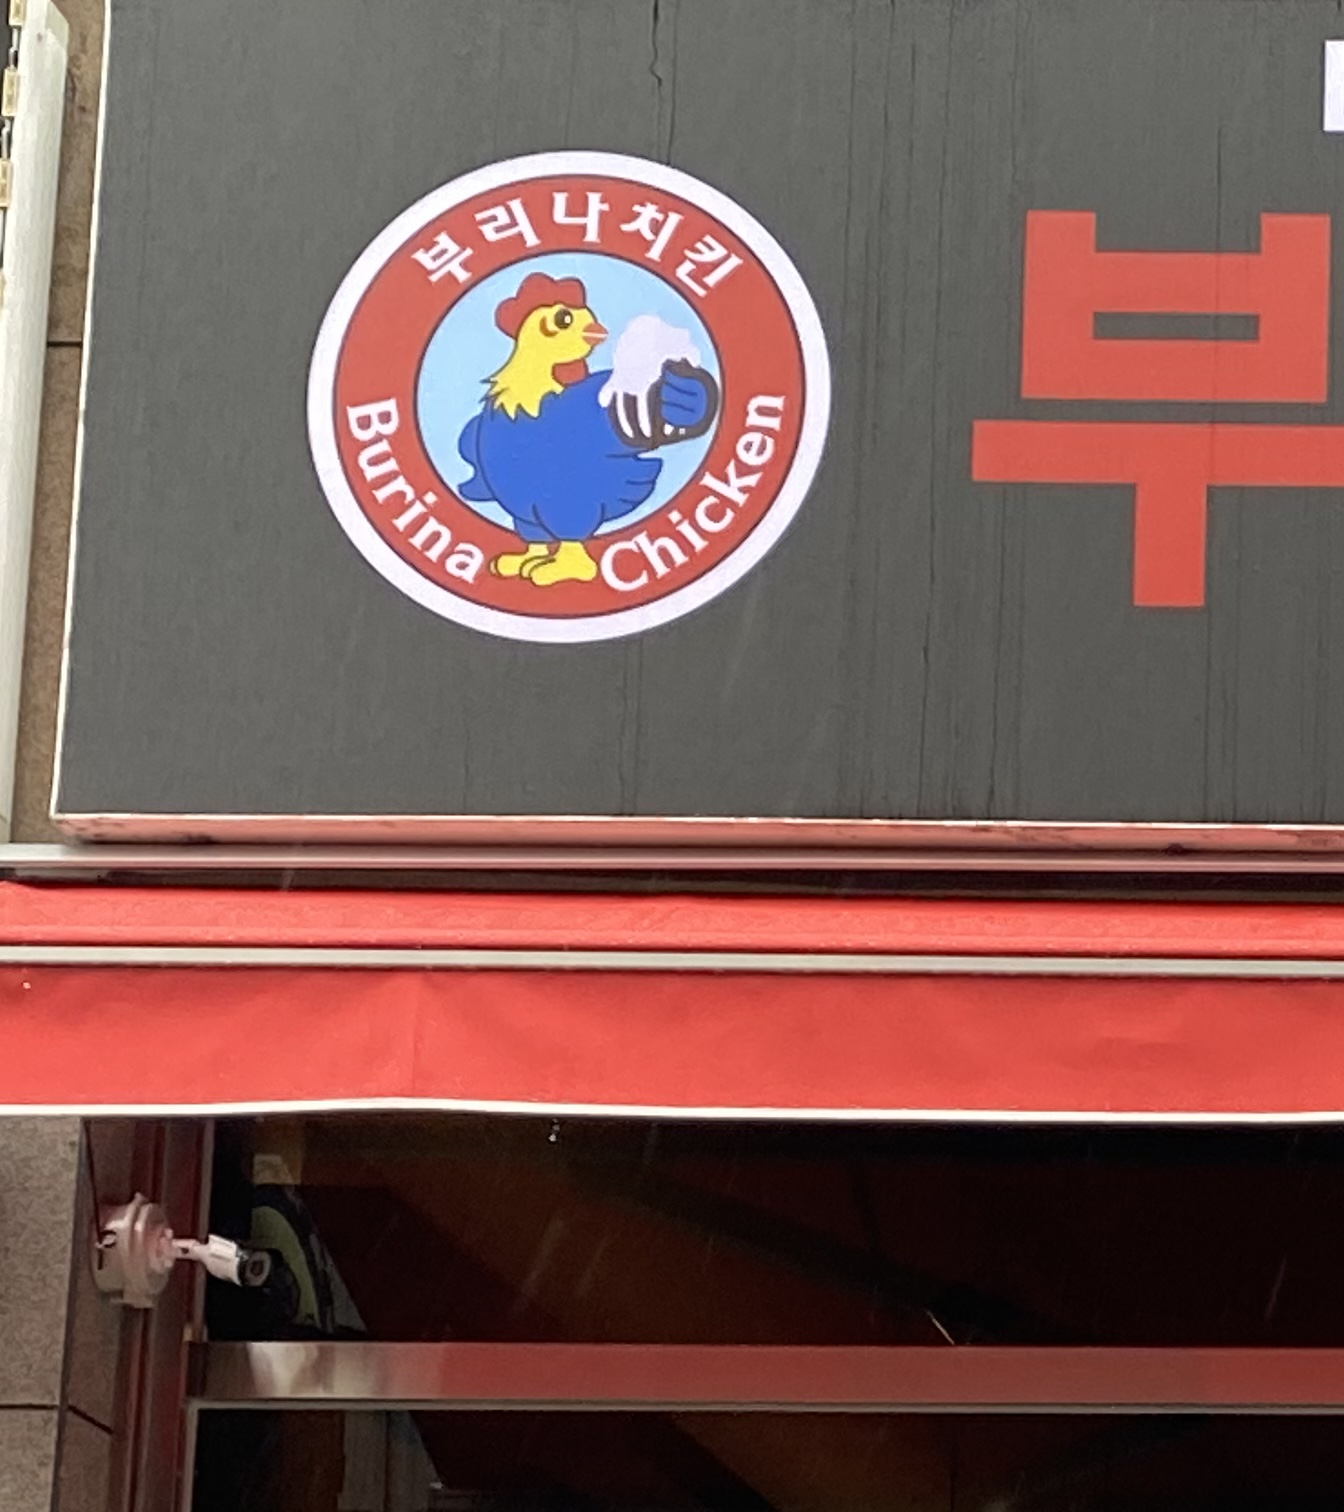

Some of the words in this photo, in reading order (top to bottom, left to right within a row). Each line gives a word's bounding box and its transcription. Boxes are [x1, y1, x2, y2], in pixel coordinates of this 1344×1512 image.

[410, 192, 743, 297] 부리나치킨
[346, 397, 485, 584] Burina
[599, 395, 786, 593] Chicken
